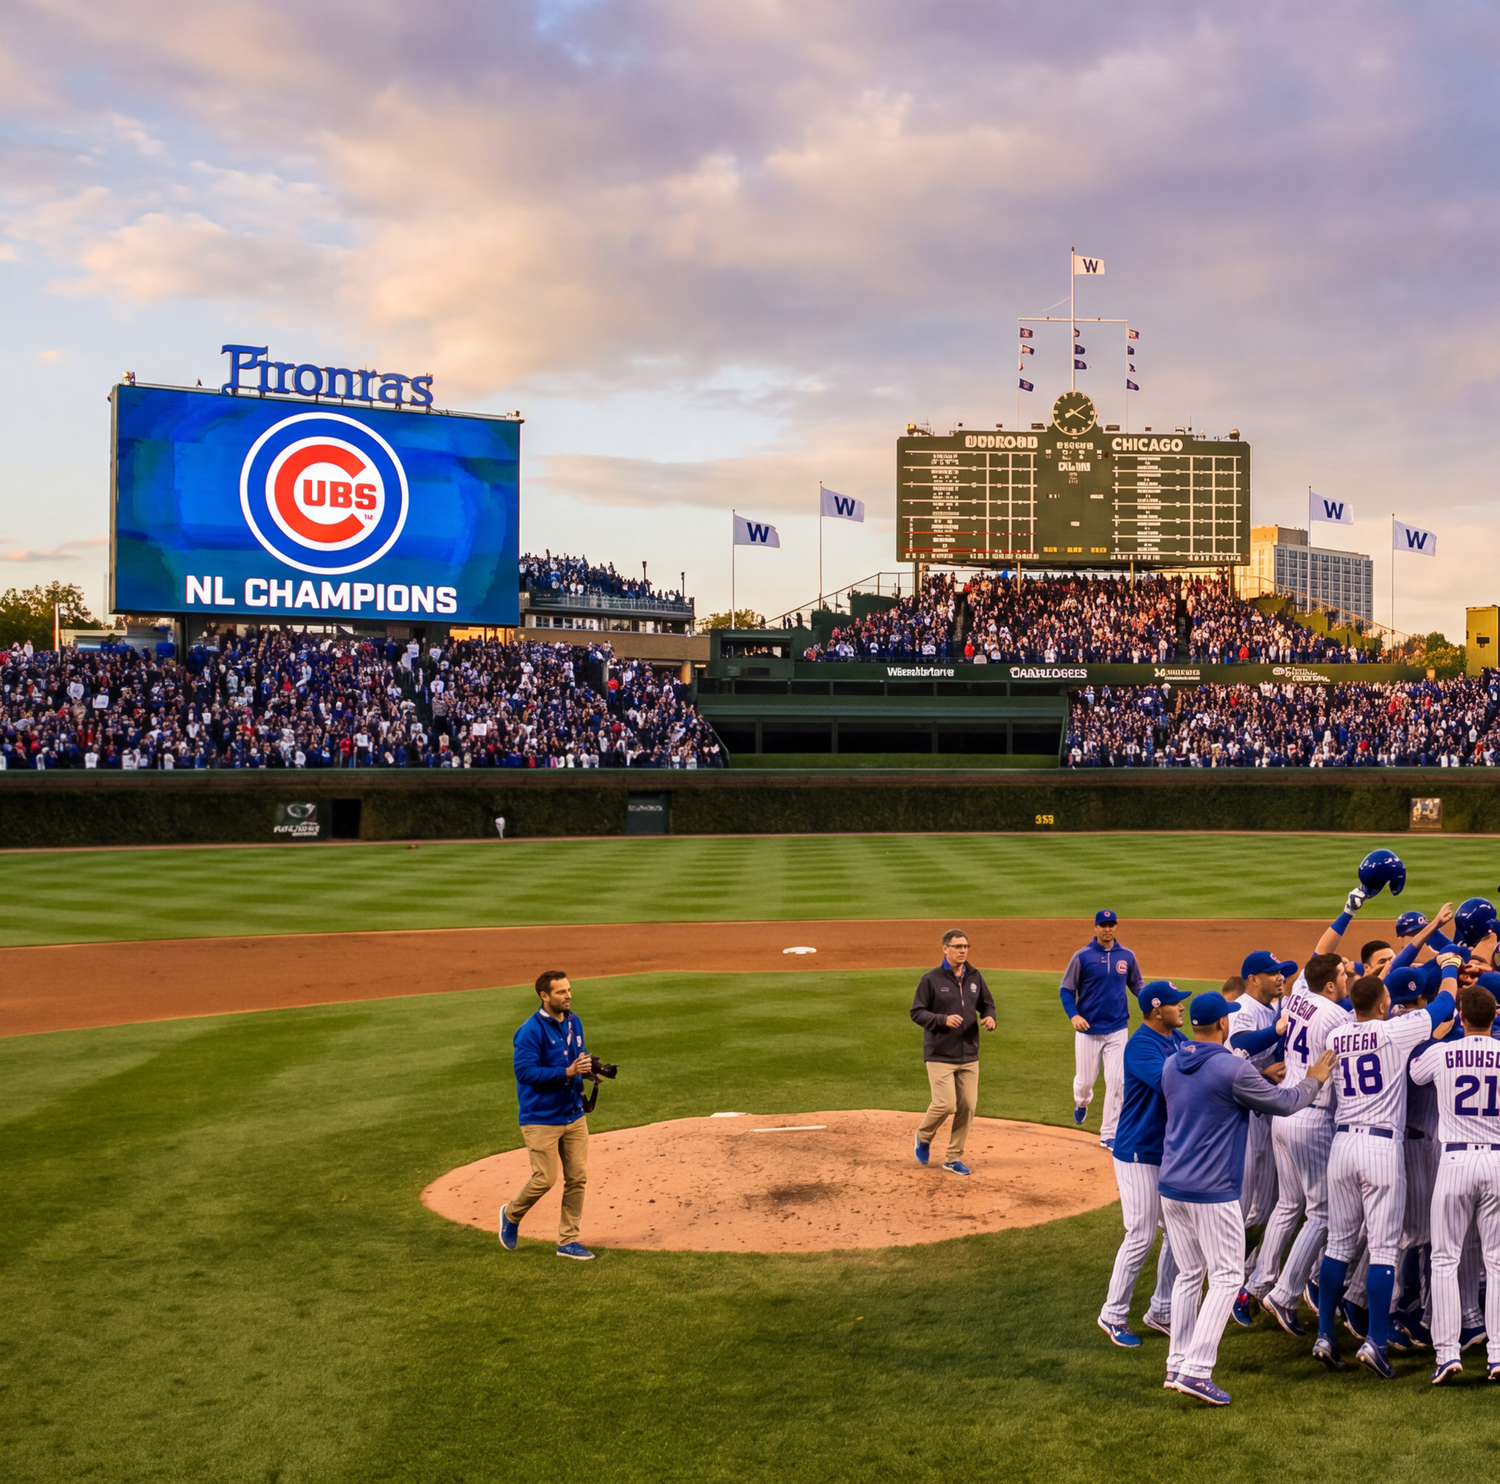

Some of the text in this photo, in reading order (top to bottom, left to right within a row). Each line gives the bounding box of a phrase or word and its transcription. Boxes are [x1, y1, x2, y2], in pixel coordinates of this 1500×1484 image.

[1082, 258, 1099, 274] W
[1111, 437, 1184, 453] CHICAGO
[833, 495, 856, 517] W
[1323, 499, 1344, 520] W
[746, 521, 770, 543] W
[1405, 528, 1428, 550] W
[185, 574, 458, 614] NL CHAMPIONS
[1340, 1053, 1384, 1098] 18
[1454, 1074, 1500, 1117] 21
